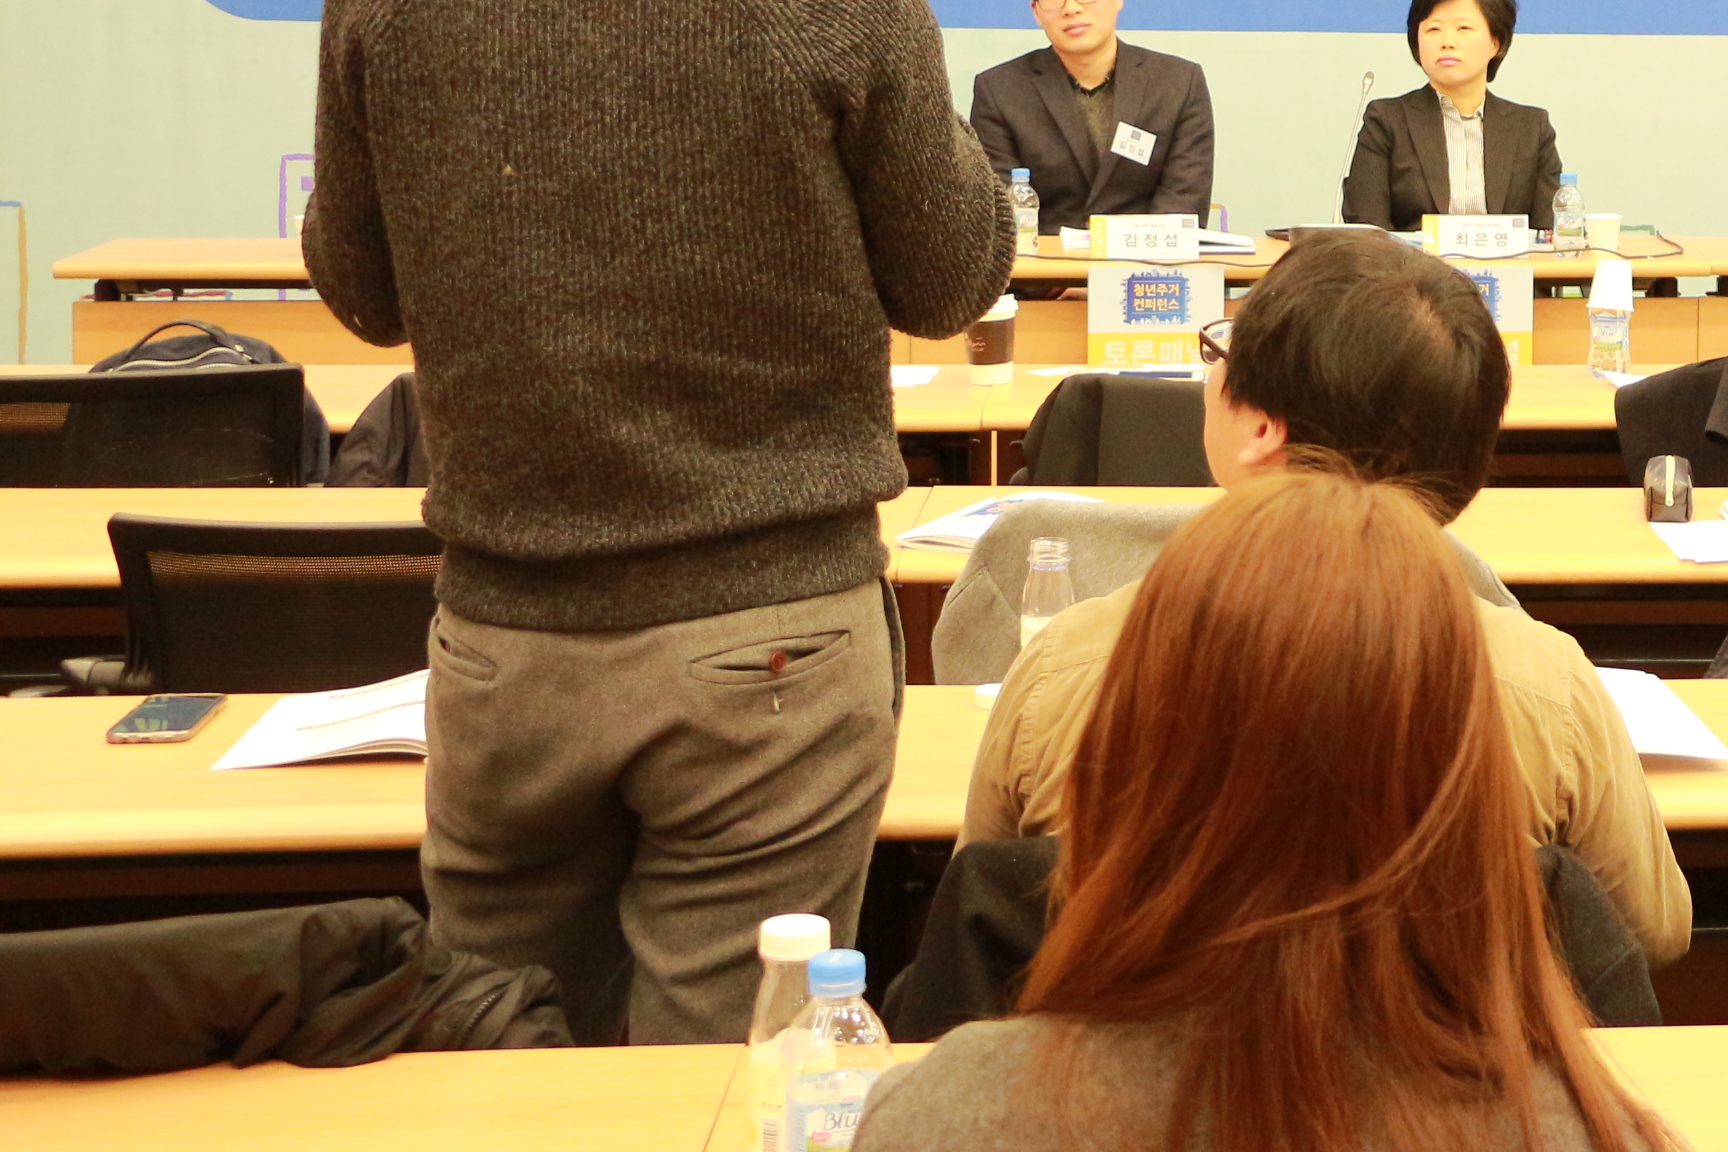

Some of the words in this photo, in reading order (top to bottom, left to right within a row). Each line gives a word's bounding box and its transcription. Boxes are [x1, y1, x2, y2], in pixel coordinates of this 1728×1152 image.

[1123, 232, 1179, 248] 김정섭
[1454, 231, 1509, 248] 최은영
[1133, 283, 1180, 297] 청년주거
[1133, 298, 1181, 312] 컨퍼런스
[823, 1111, 860, 1131] Blu
